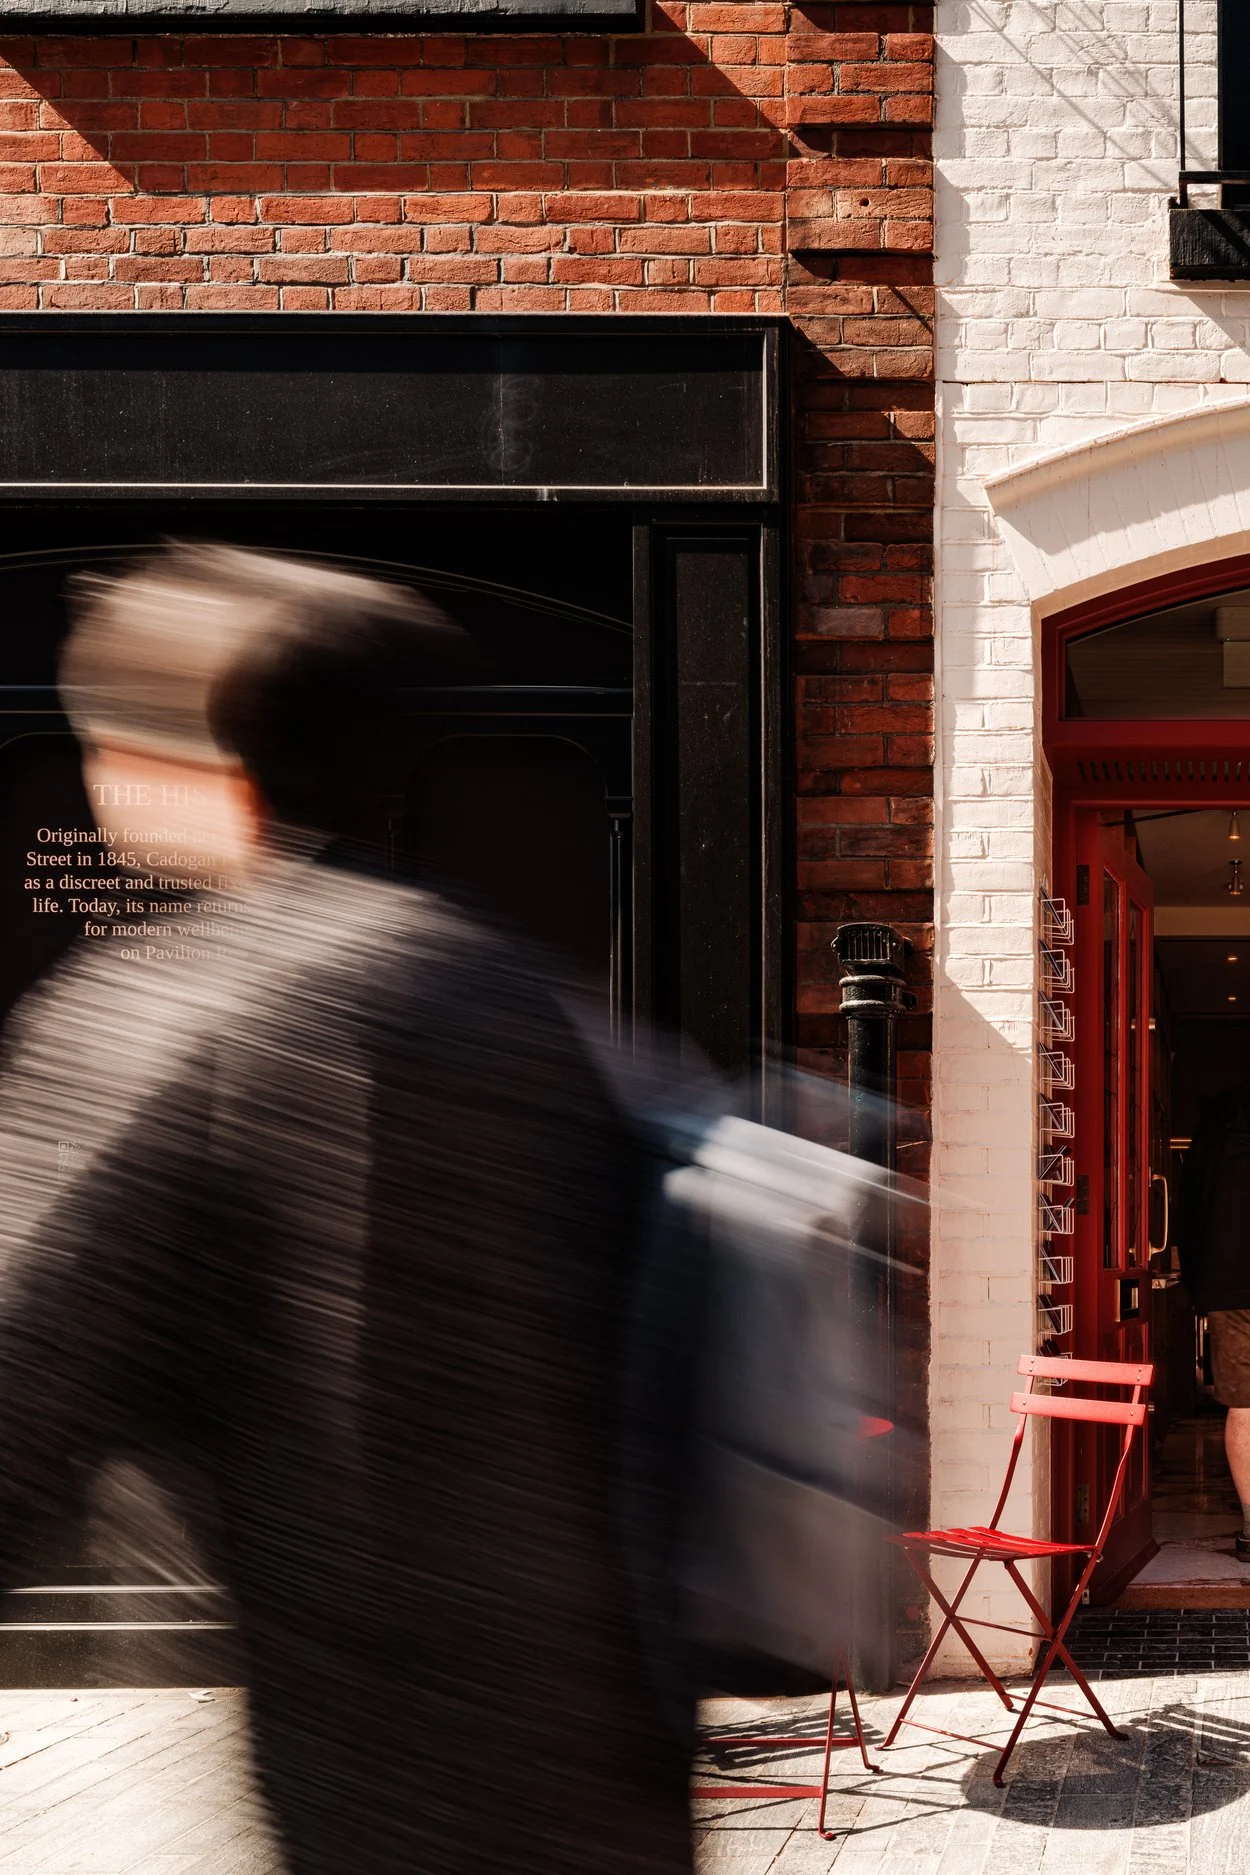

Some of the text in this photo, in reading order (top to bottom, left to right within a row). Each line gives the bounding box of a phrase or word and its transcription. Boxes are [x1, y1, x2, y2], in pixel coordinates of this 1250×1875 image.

[93, 784, 152, 806] THE
[37, 828, 118, 846] Originally
[123, 828, 186, 843] founded
[26, 852, 72, 866] Street
[77, 852, 92, 866] in
[98, 852, 141, 869] 1845,
[146, 852, 216, 870] Cadogan
[24, 879, 42, 890] as
[45, 879, 54, 890] a
[59, 875, 121, 890] discreet
[125, 875, 154, 890] and
[159, 875, 212, 890] trusted
[33, 899, 63, 913] life.
[68, 900, 121, 916] Today,
[126, 899, 145, 913] its
[149, 903, 192, 913] name
[85, 922, 108, 936] for
[112, 922, 172, 936] modern
[120, 950, 140, 961] on
[145, 946, 210, 960] Pavilion
